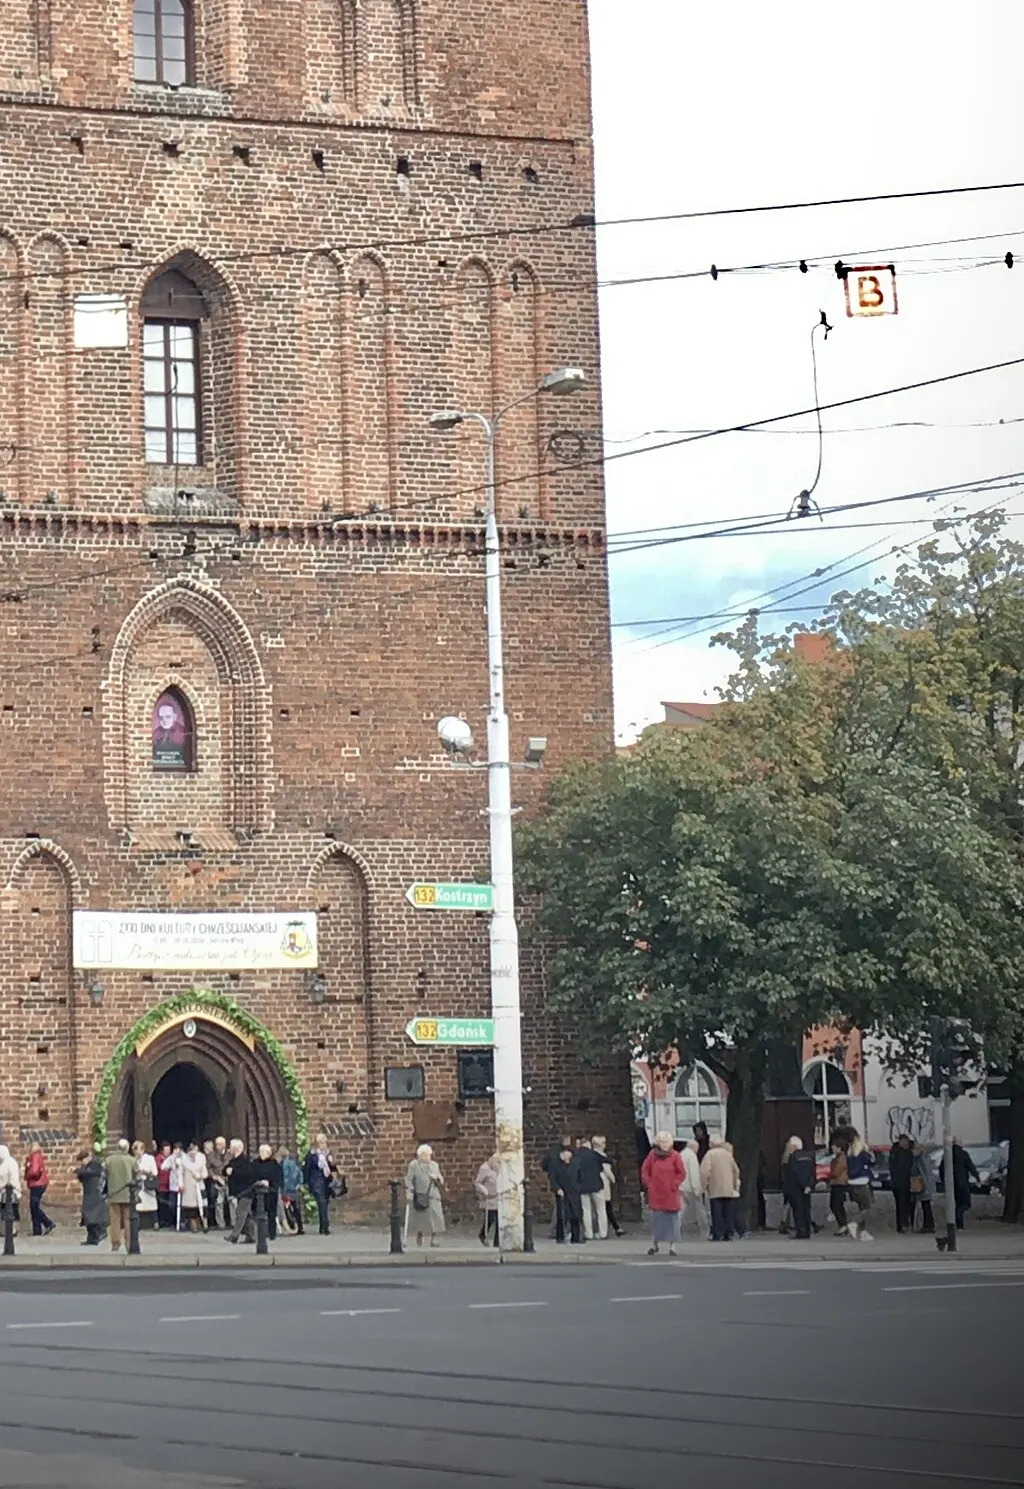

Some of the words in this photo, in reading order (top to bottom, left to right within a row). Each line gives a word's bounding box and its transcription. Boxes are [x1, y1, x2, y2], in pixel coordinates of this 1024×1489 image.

[858, 276, 884, 307] B
[416, 889, 434, 902] 132
[436, 887, 487, 905] Kostrzyn
[417, 1024, 436, 1038] 132
[439, 1022, 487, 1038] Gdańsk
